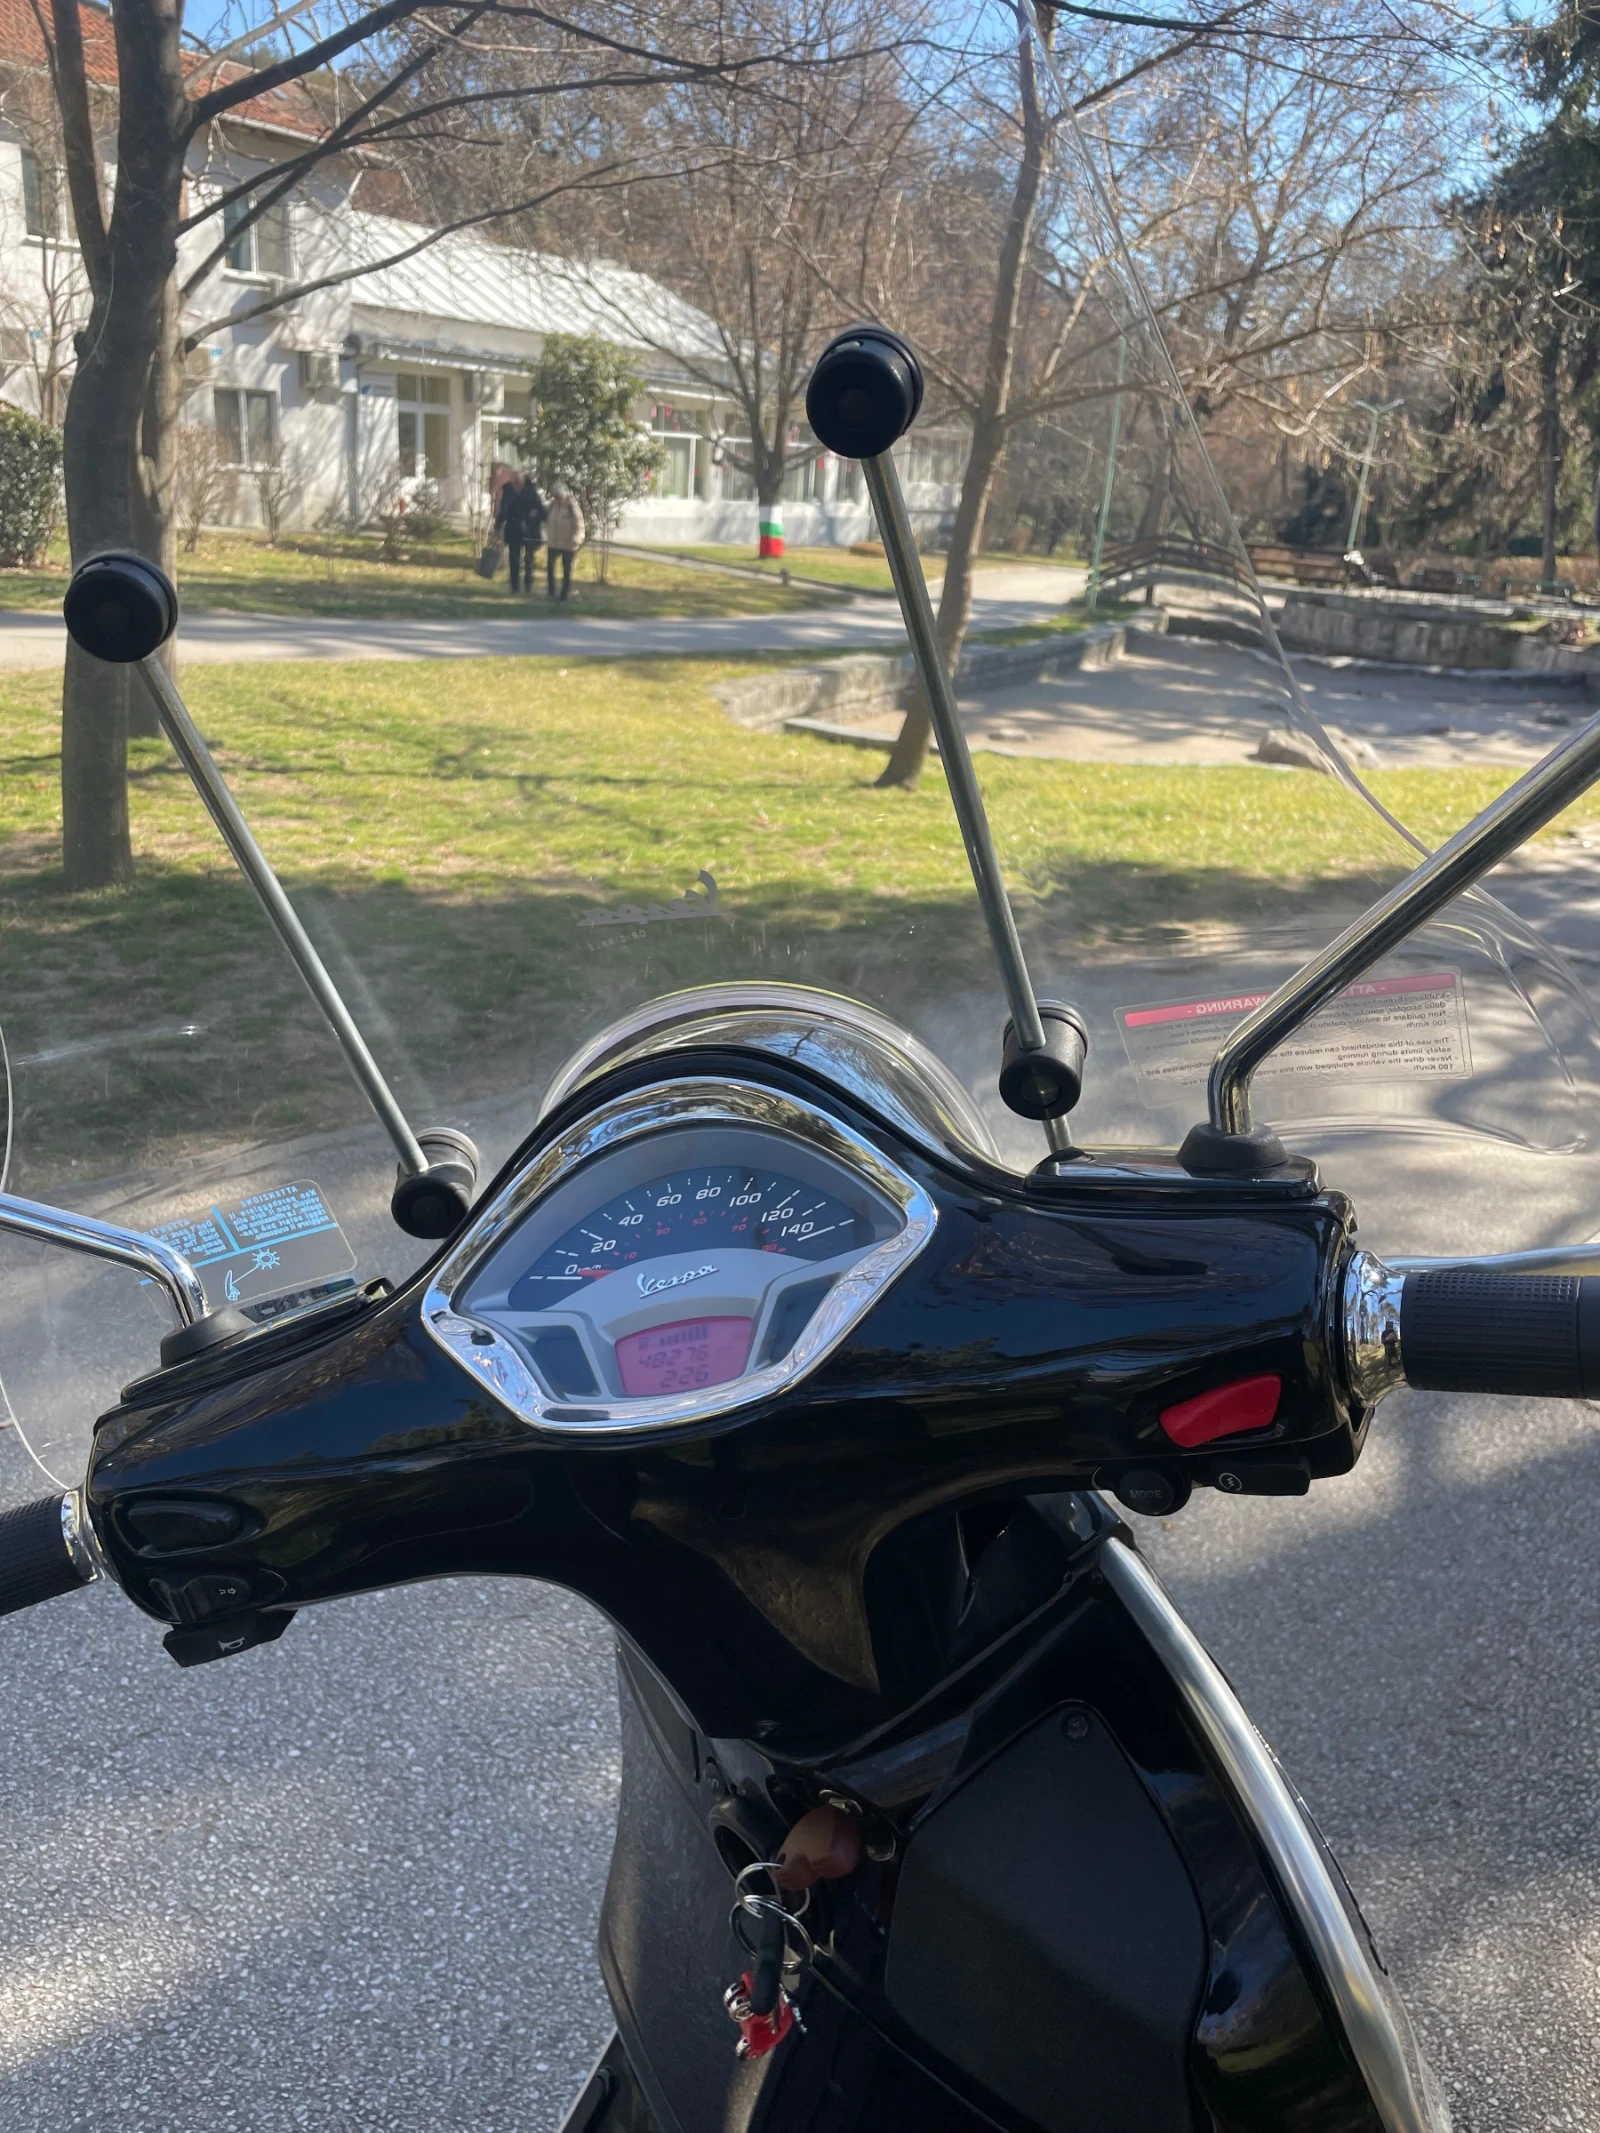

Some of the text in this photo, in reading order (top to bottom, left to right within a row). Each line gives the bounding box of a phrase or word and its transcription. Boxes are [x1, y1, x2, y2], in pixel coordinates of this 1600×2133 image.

[656, 1193, 683, 1207] 60
[695, 1186, 722, 1200] 80
[729, 1192, 762, 1208] 100
[618, 1213, 644, 1227] 40
[692, 1217, 708, 1226] 50
[761, 1207, 795, 1223] 120
[655, 1227, 671, 1236] 30
[732, 1223, 747, 1232] 70
[781, 1221, 815, 1237] 140
[590, 1239, 616, 1253] 20
[624, 1251, 637, 1260] 10
[564, 1263, 578, 1275] 0
[637, 1264, 720, 1300] Vespa
[1128, 1488, 1164, 1500] MODE
